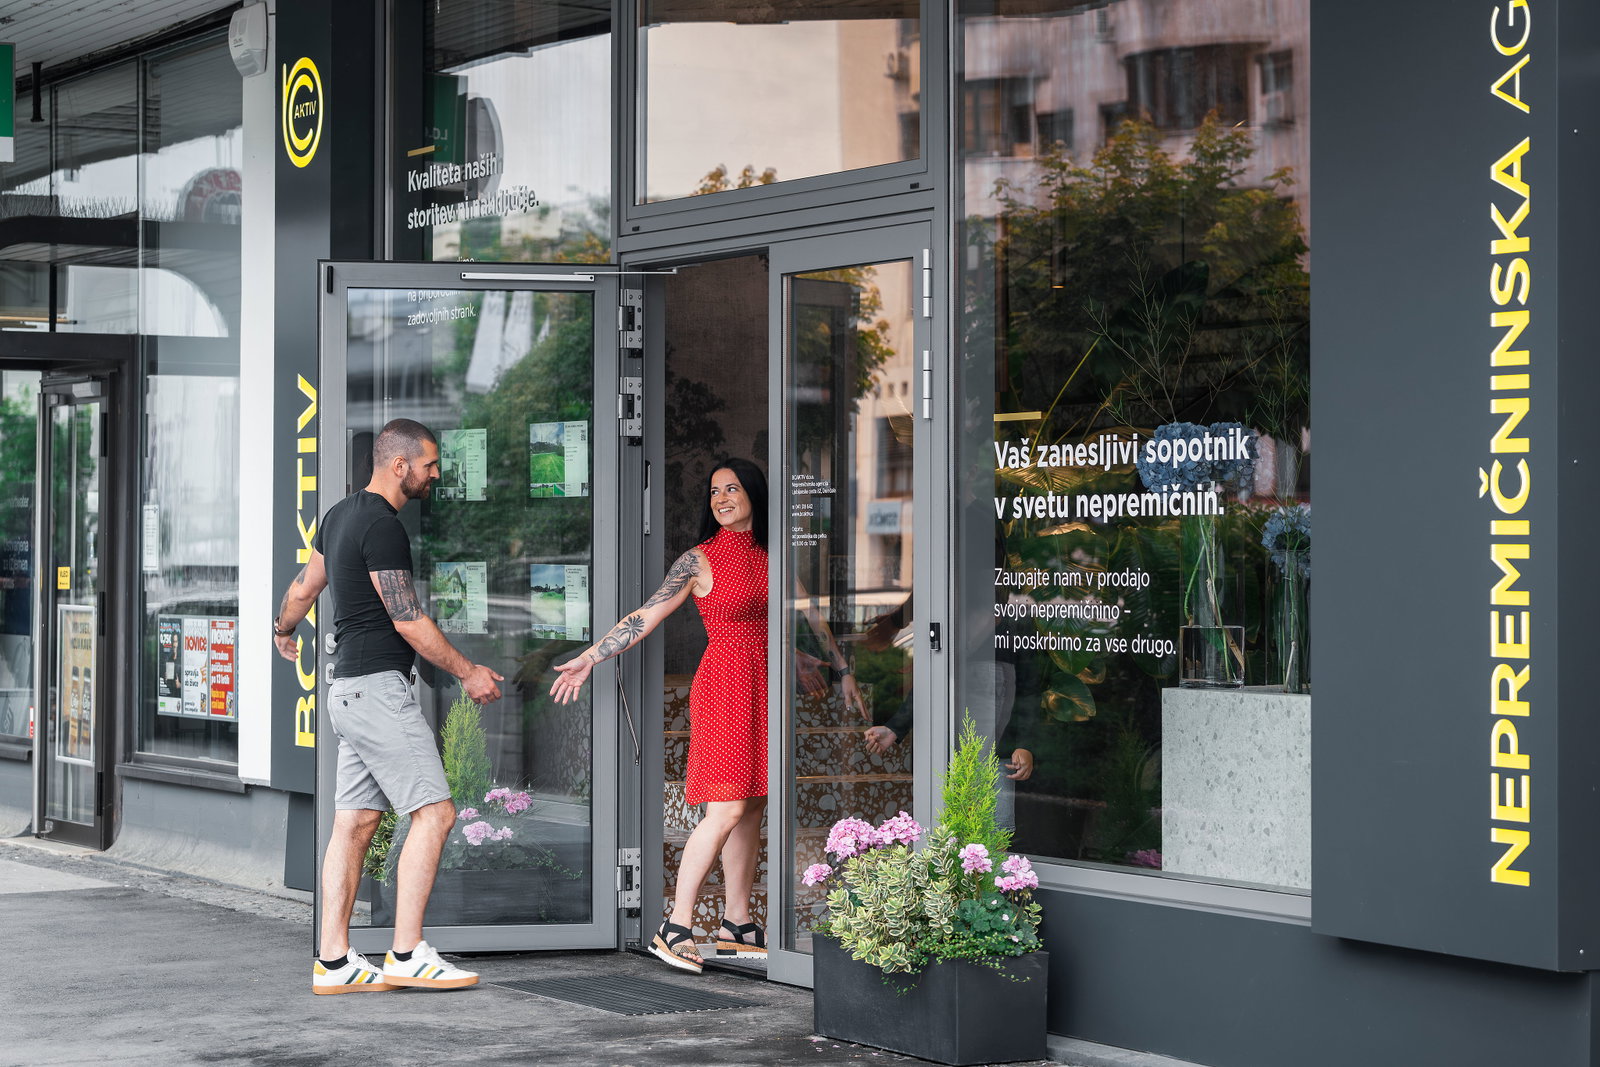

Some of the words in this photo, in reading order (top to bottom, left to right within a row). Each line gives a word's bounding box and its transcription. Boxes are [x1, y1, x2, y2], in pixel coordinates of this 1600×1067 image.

[294, 100, 316, 119] AKTIV
[408, 162, 461, 192] Kvaliteta
[465, 152, 497, 180] naših
[408, 203, 454, 230] storitev
[408, 308, 449, 326] zadovoljnih
[451, 303, 476, 320] strank.
[994, 438, 1031, 469] Vaš
[1037, 433, 1138, 471] zanesljivi
[1146, 428, 1250, 468] sopotnik
[994, 498, 1006, 519] v
[1013, 491, 1068, 519] svetu
[1076, 484, 1224, 523] nepremičnin.
[1479, 136, 1530, 887] NEPREMIČNINSKA
[994, 568, 1050, 589] Zaupajte
[1054, 571, 1081, 586] nam
[1085, 572, 1093, 586] v
[1098, 568, 1150, 590] prodajo
[994, 600, 1027, 620] svojo
[1030, 599, 1120, 621] nepremičnino
[184, 636, 207, 651] novice
[994, 631, 1009, 649] mi
[1013, 632, 1081, 651] poskrbimo
[1085, 637, 1101, 651] za
[1105, 638, 1128, 652] vse
[1132, 634, 1177, 658] drugo.
